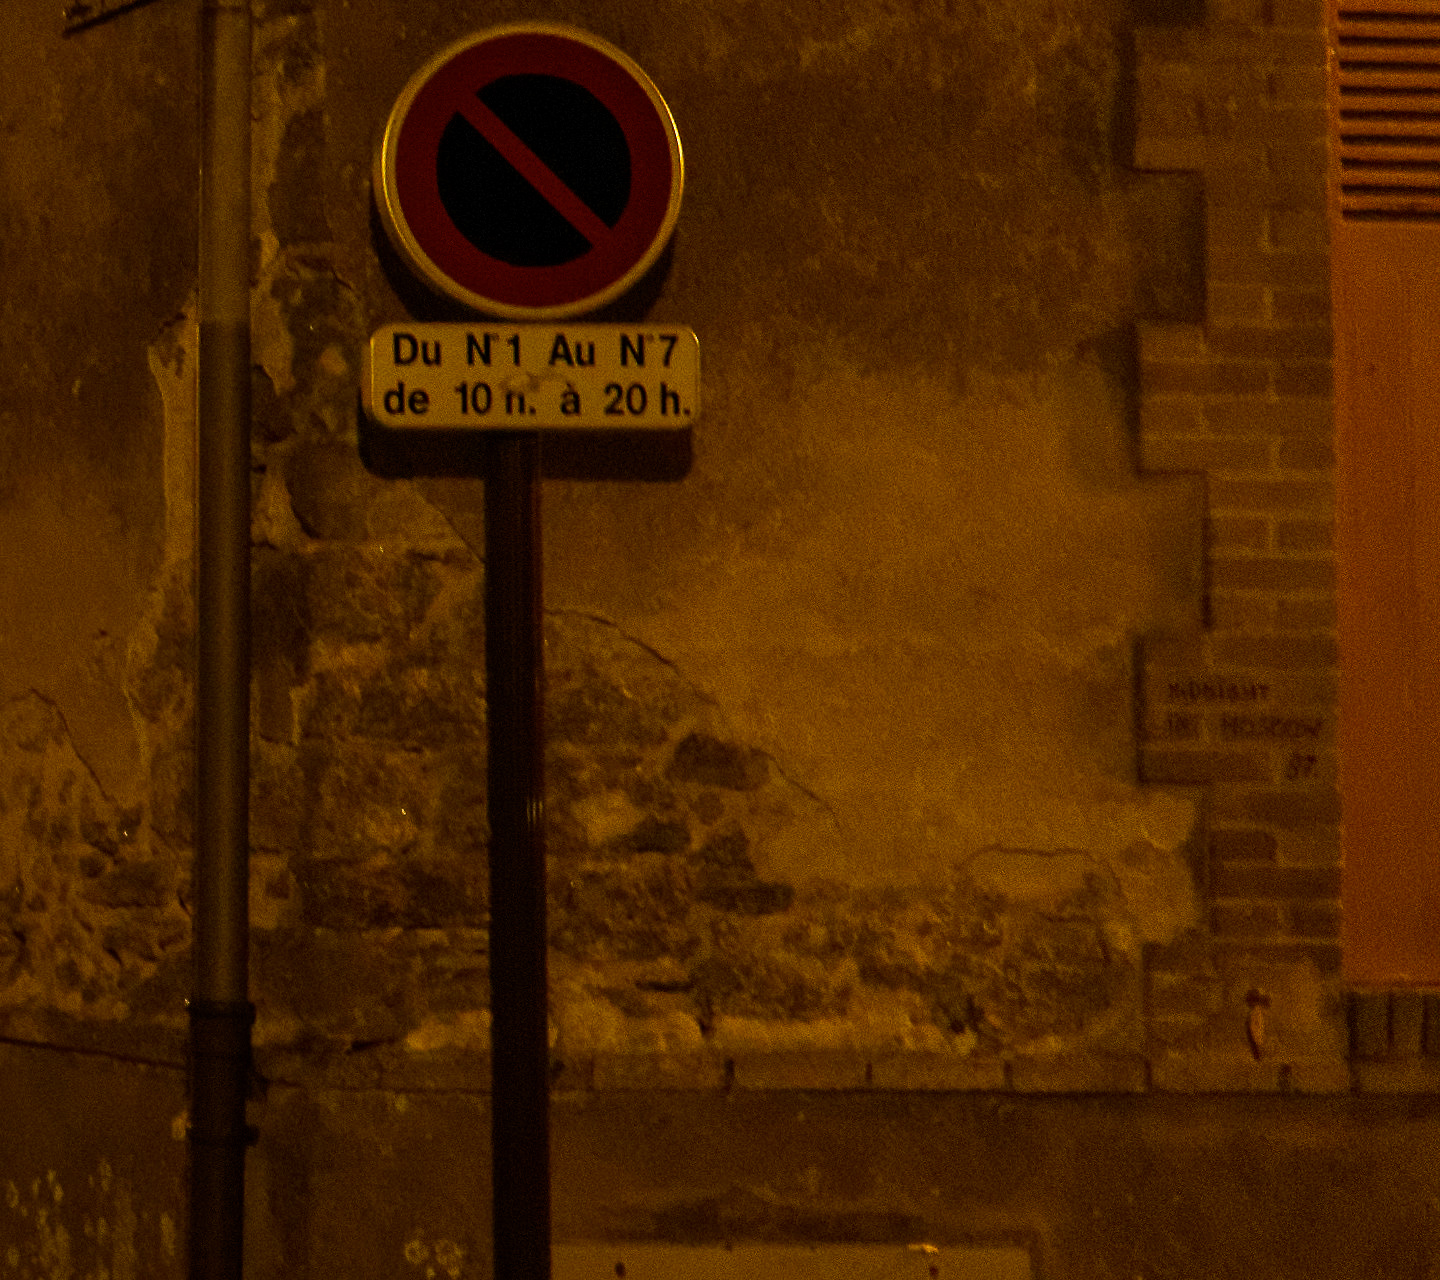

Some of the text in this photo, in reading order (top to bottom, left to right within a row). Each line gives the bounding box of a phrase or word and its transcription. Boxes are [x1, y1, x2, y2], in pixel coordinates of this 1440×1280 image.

[392, 331, 442, 367] Du
[548, 332, 596, 368] Au
[383, 380, 430, 415] de
[560, 381, 582, 415] à
